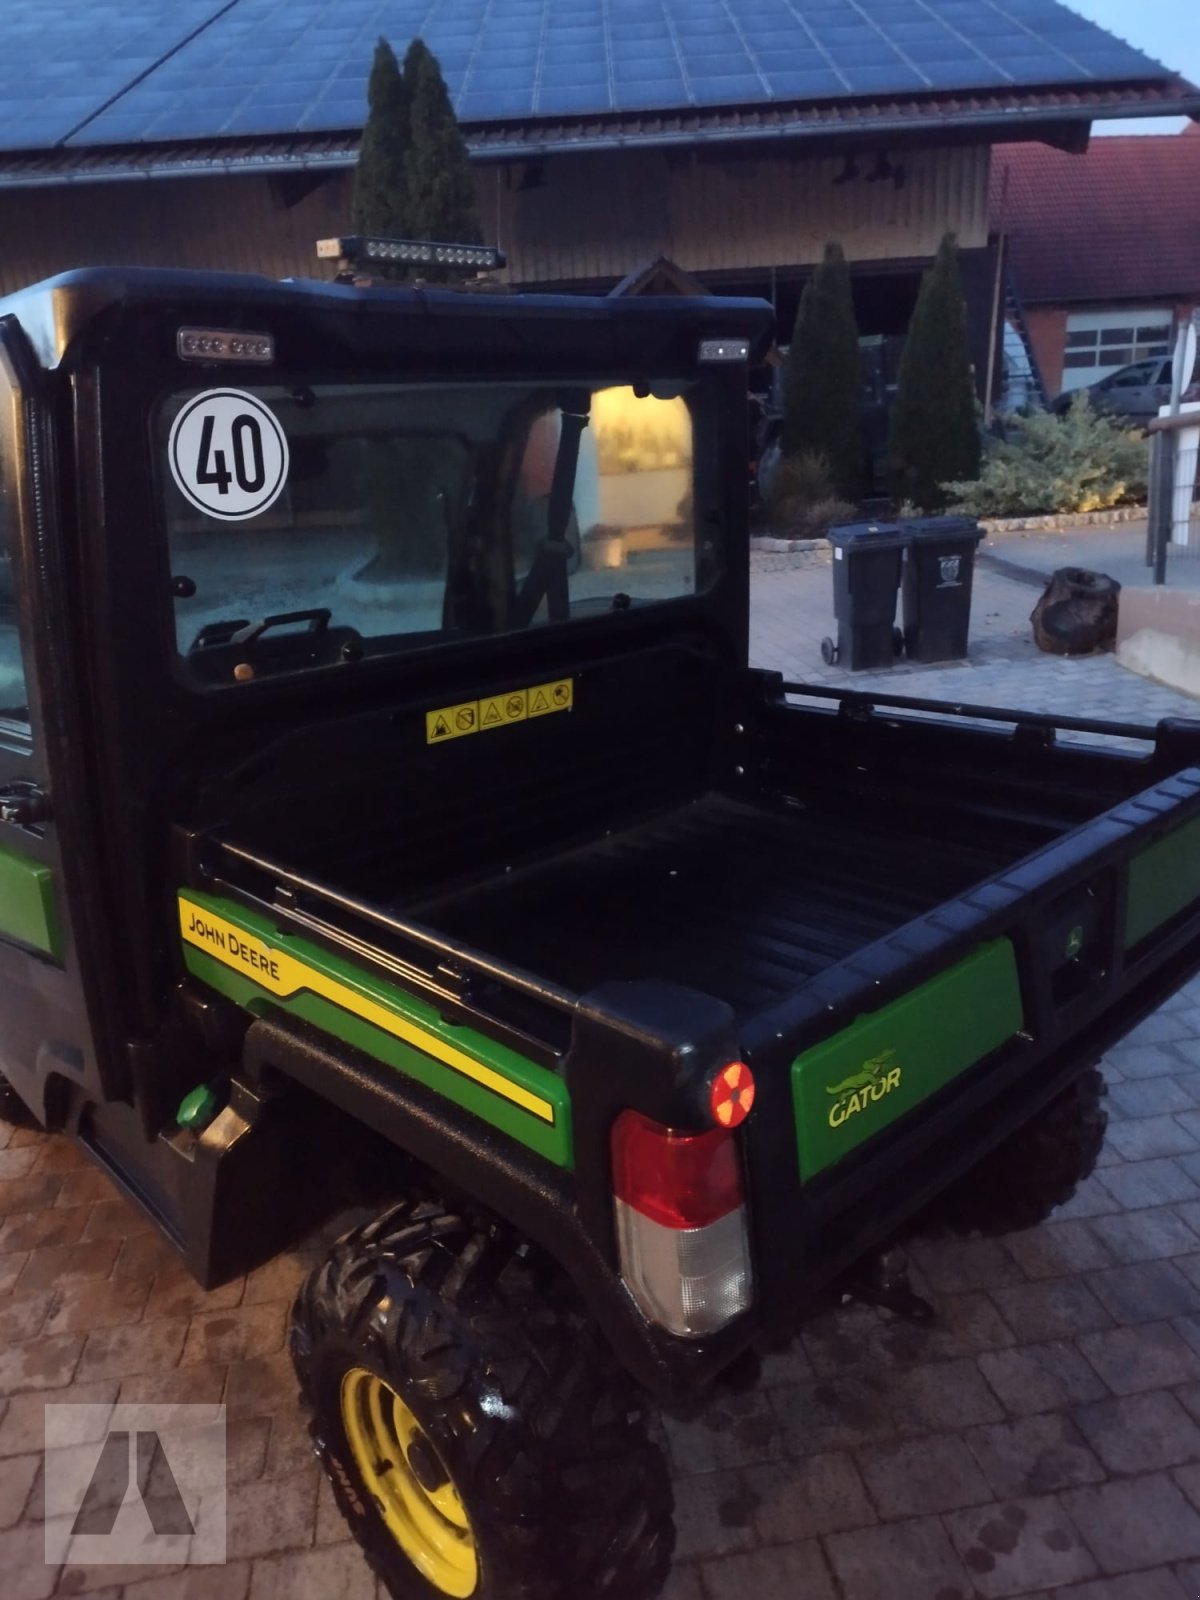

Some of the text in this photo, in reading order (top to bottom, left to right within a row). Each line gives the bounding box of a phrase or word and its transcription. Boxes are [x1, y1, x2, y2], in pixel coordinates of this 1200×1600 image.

[196, 413, 265, 495] 40
[189, 912, 280, 982] JOHN DEERE
[828, 1067, 902, 1128] GATOR
